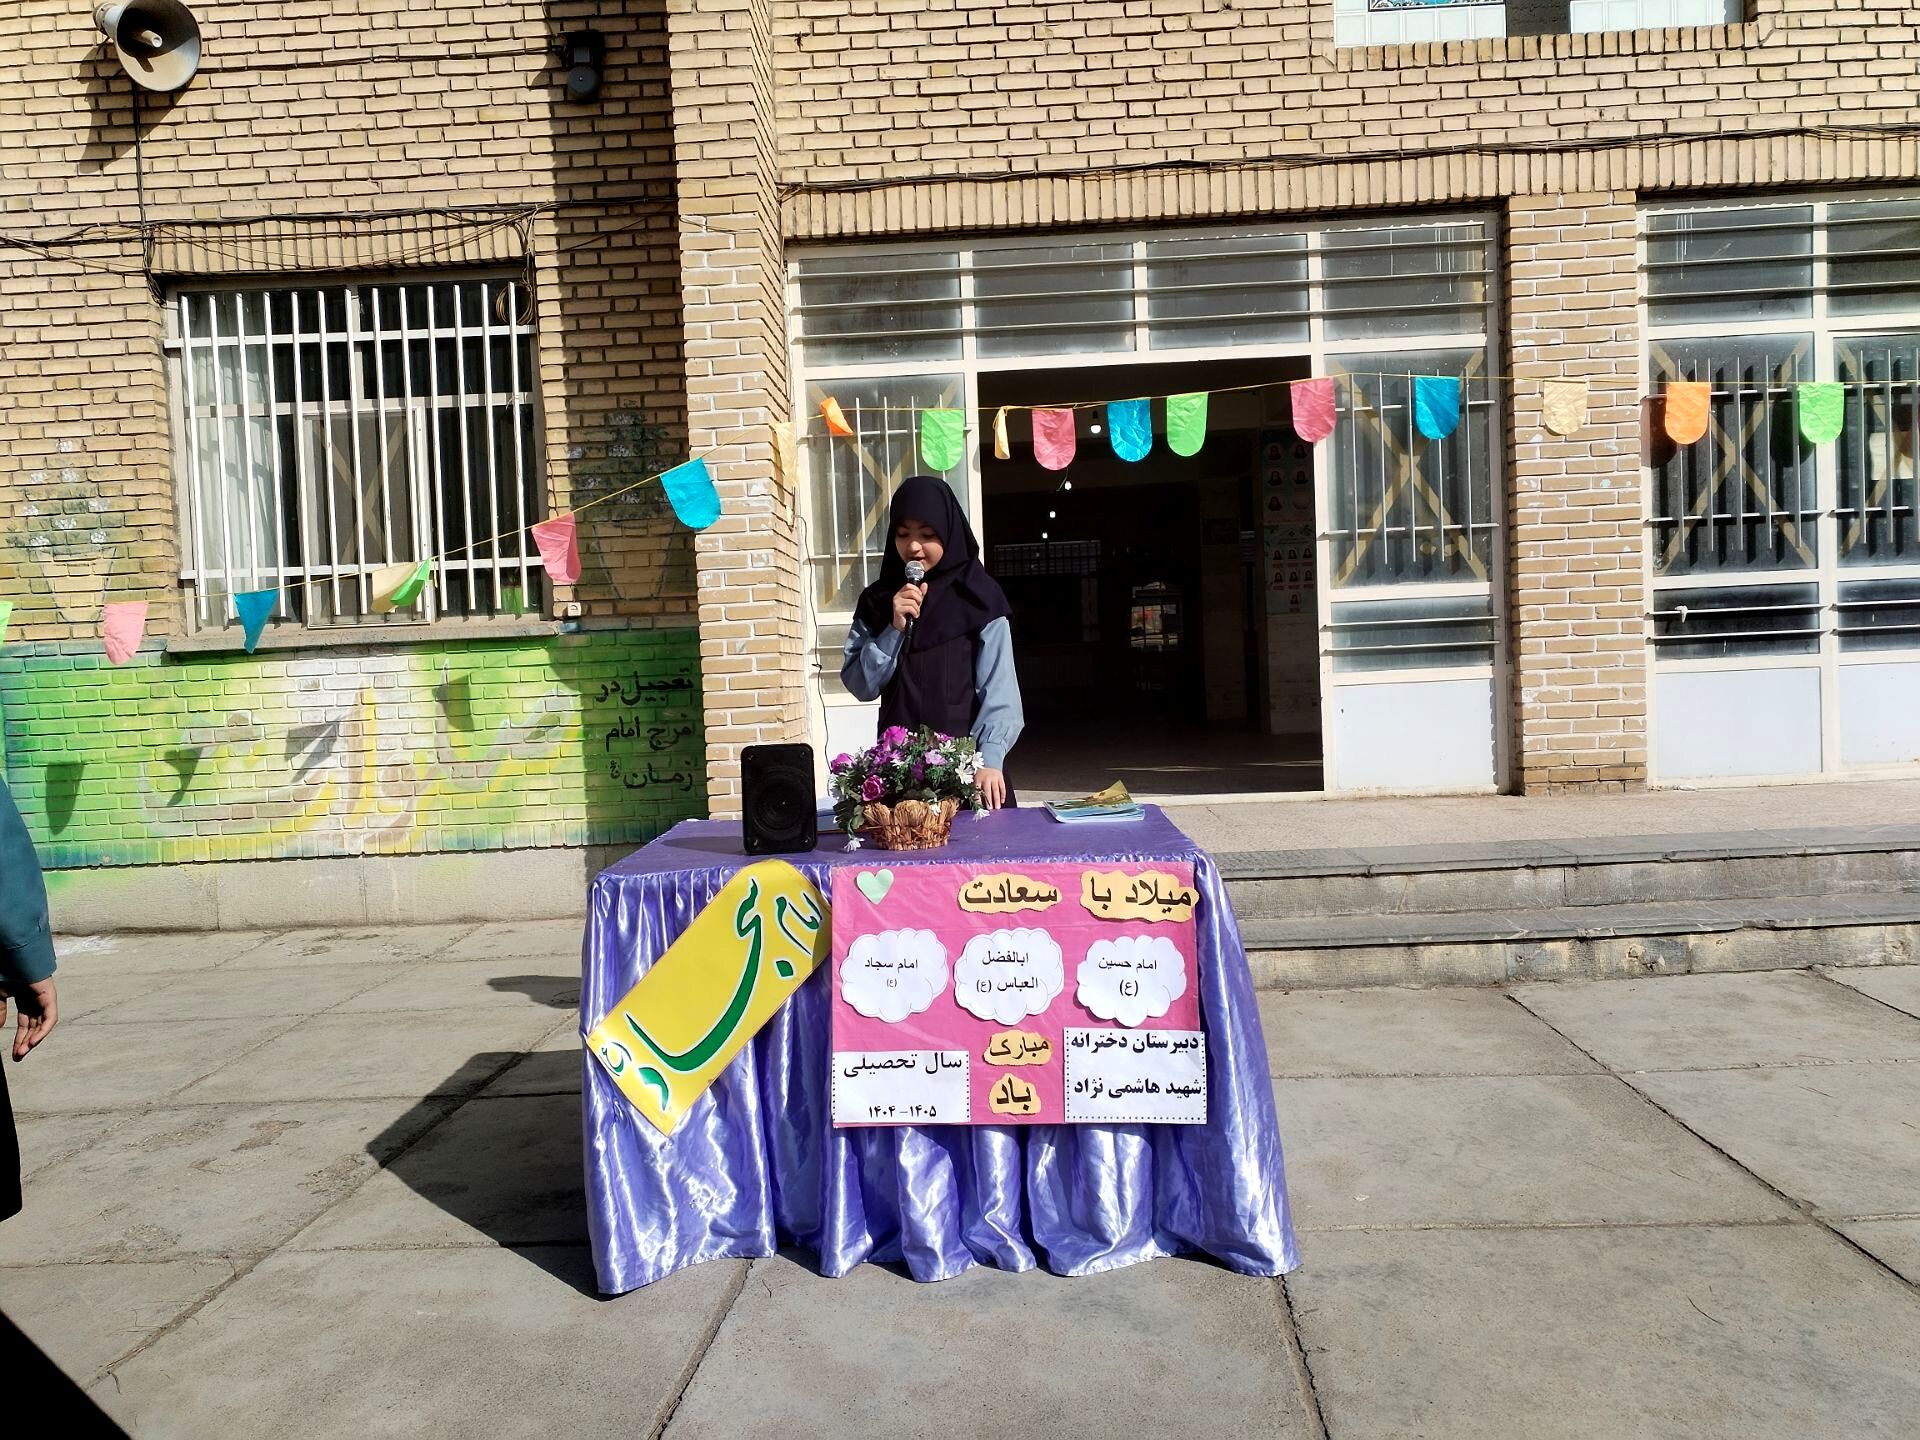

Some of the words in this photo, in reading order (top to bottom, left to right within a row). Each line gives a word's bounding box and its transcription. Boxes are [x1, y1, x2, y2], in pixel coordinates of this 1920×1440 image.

[594, 680, 621, 702] در
[606, 716, 641, 752] امام
[623, 761, 693, 791] زمان
[963, 878, 1058, 905] سعادت
[1090, 877, 1112, 910] با
[1125, 878, 1193, 914] میلاد
[864, 956, 894, 970] سجاد
[896, 958, 919, 971] امام
[981, 950, 1029, 965] ابالفضل
[1097, 956, 1133, 971] حسین
[1135, 958, 1158, 971] امام
[996, 975, 1039, 992] العباس
[1118, 979, 1140, 997] (ع)
[988, 1036, 1050, 1060] مبارک
[1071, 1032, 1128, 1054] دخترانه
[1132, 1032, 1200, 1054] دبیرستان
[843, 1053, 918, 1078] تحصیلی
[924, 1052, 963, 1074] سال
[995, 1076, 1032, 1111] باد
[1073, 1077, 1104, 1099] نژاد
[1108, 1078, 1160, 1099] هاشمی
[1165, 1079, 1202, 1099] شهید
